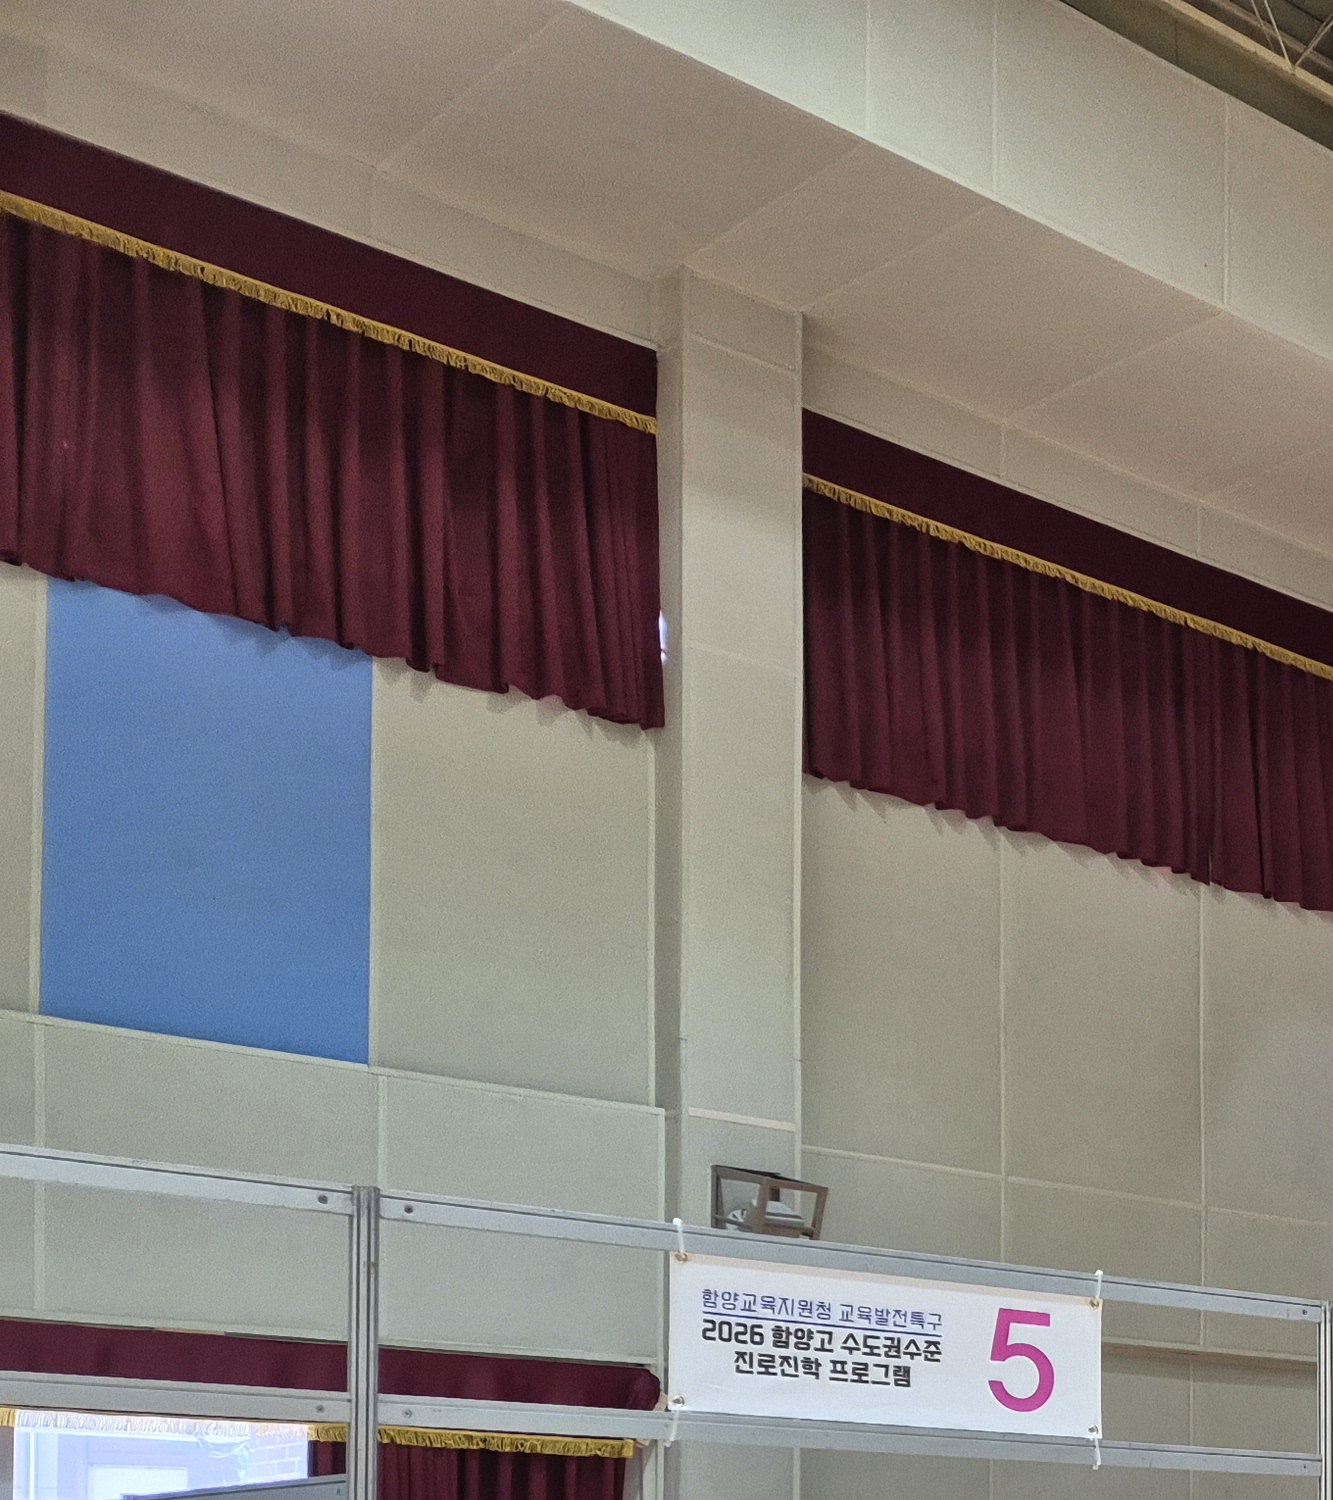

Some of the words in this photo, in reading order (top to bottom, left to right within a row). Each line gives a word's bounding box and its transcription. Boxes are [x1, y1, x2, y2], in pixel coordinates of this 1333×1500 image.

[702, 1288, 832, 1320] 함양교육지원청
[838, 1303, 943, 1331] 교육발전특구
[702, 1319, 765, 1345] 2026
[771, 1325, 834, 1353] 함양고
[840, 1333, 943, 1363] 수도권수준
[987, 1307, 1055, 1412] 5
[734, 1350, 822, 1379] 진로진학
[829, 1359, 912, 1388] 프로그램
